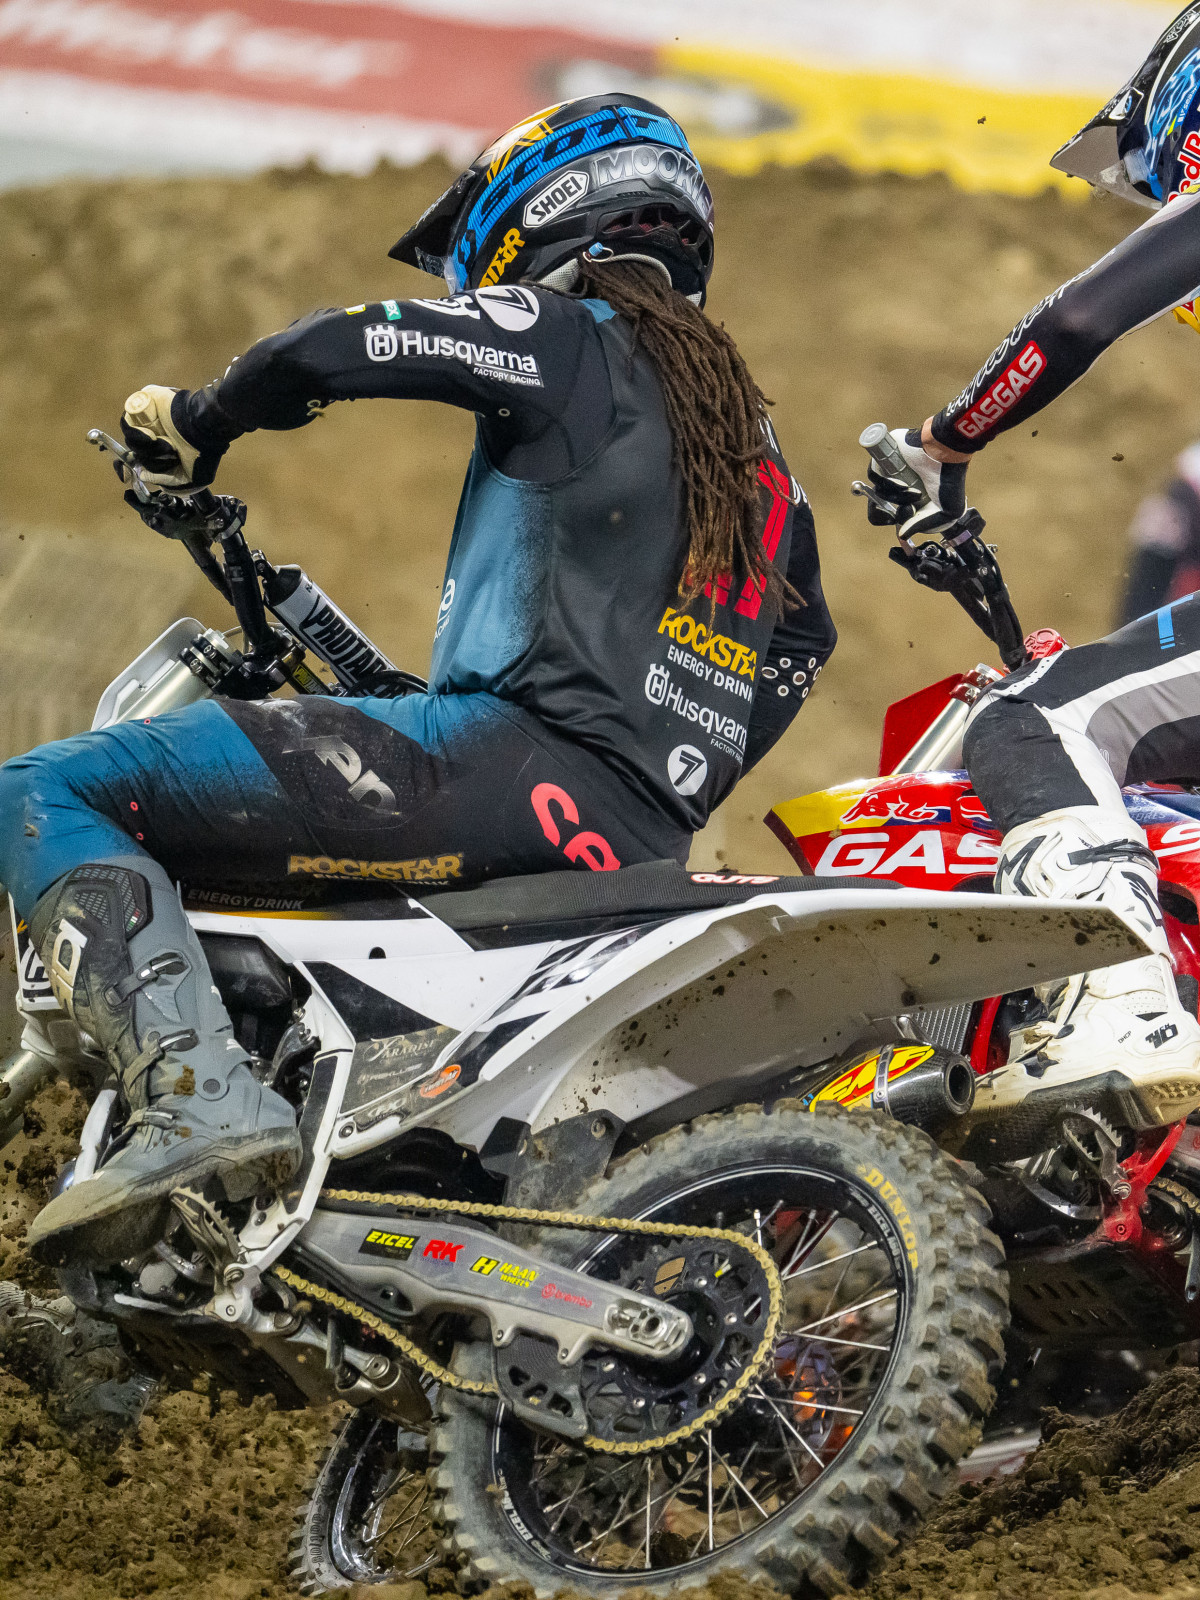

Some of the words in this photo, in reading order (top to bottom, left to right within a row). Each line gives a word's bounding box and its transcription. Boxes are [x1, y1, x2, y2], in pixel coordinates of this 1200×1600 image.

[530, 175, 583, 222] SHOEI
[402, 331, 538, 374] Husqvarna
[473, 367, 509, 381] FACTORY
[510, 373, 541, 386] RACING
[957, 345, 1043, 439] GASGAS
[657, 606, 758, 682] ROCKSTA
[667, 645, 715, 682] ENERGY
[665, 682, 748, 750] Husqvarn
[289, 855, 462, 880] ROCKSTAR
[188, 889, 250, 907] ENERGY
[253, 897, 303, 910] DRINK
[864, 1168, 919, 1270] DUNLOP
[366, 1231, 414, 1250] EXCEL
[423, 1239, 465, 1263] RK
[499, 1262, 539, 1282] HAAN
[500, 1275, 530, 1288] WHEELS
[555, 1288, 593, 1309] brembo
